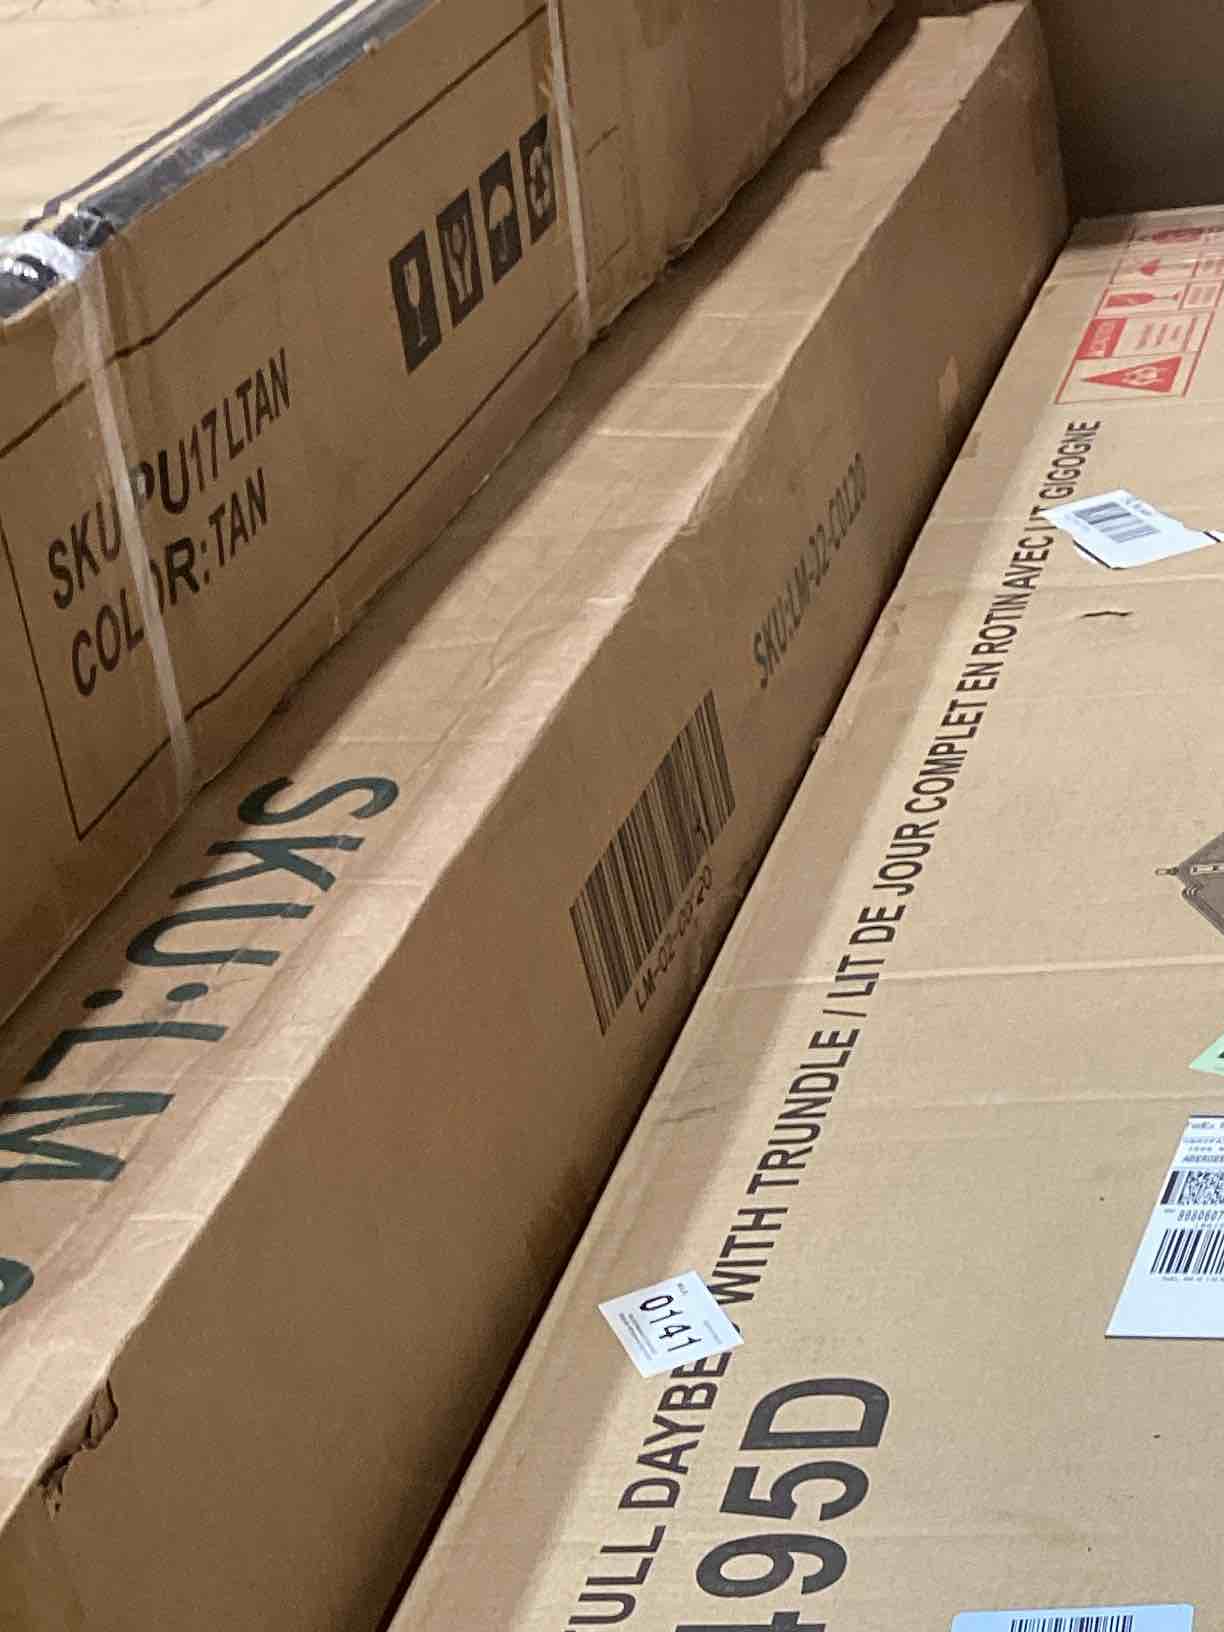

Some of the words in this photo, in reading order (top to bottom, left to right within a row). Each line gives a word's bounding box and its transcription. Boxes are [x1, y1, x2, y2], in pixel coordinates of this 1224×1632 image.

[1039, 420, 1101, 499] GIGOGNE
[1003, 536, 1054, 590] AVEC
[972, 588, 1028, 656] ROTIN
[955, 660, 1005, 692] EN
[904, 698, 987, 813] COMPLET
[873, 818, 940, 897] JOUR
[848, 903, 906, 946] DE
[826, 953, 885, 999] LIT
[822, 1007, 868, 1018] /
[746, 1028, 861, 1195] TRUNDLE
[706, 1206, 789, 1306] WITH
[639, 1295, 702, 1352] 0141
[617, 1321, 743, 1510] DAYBE
